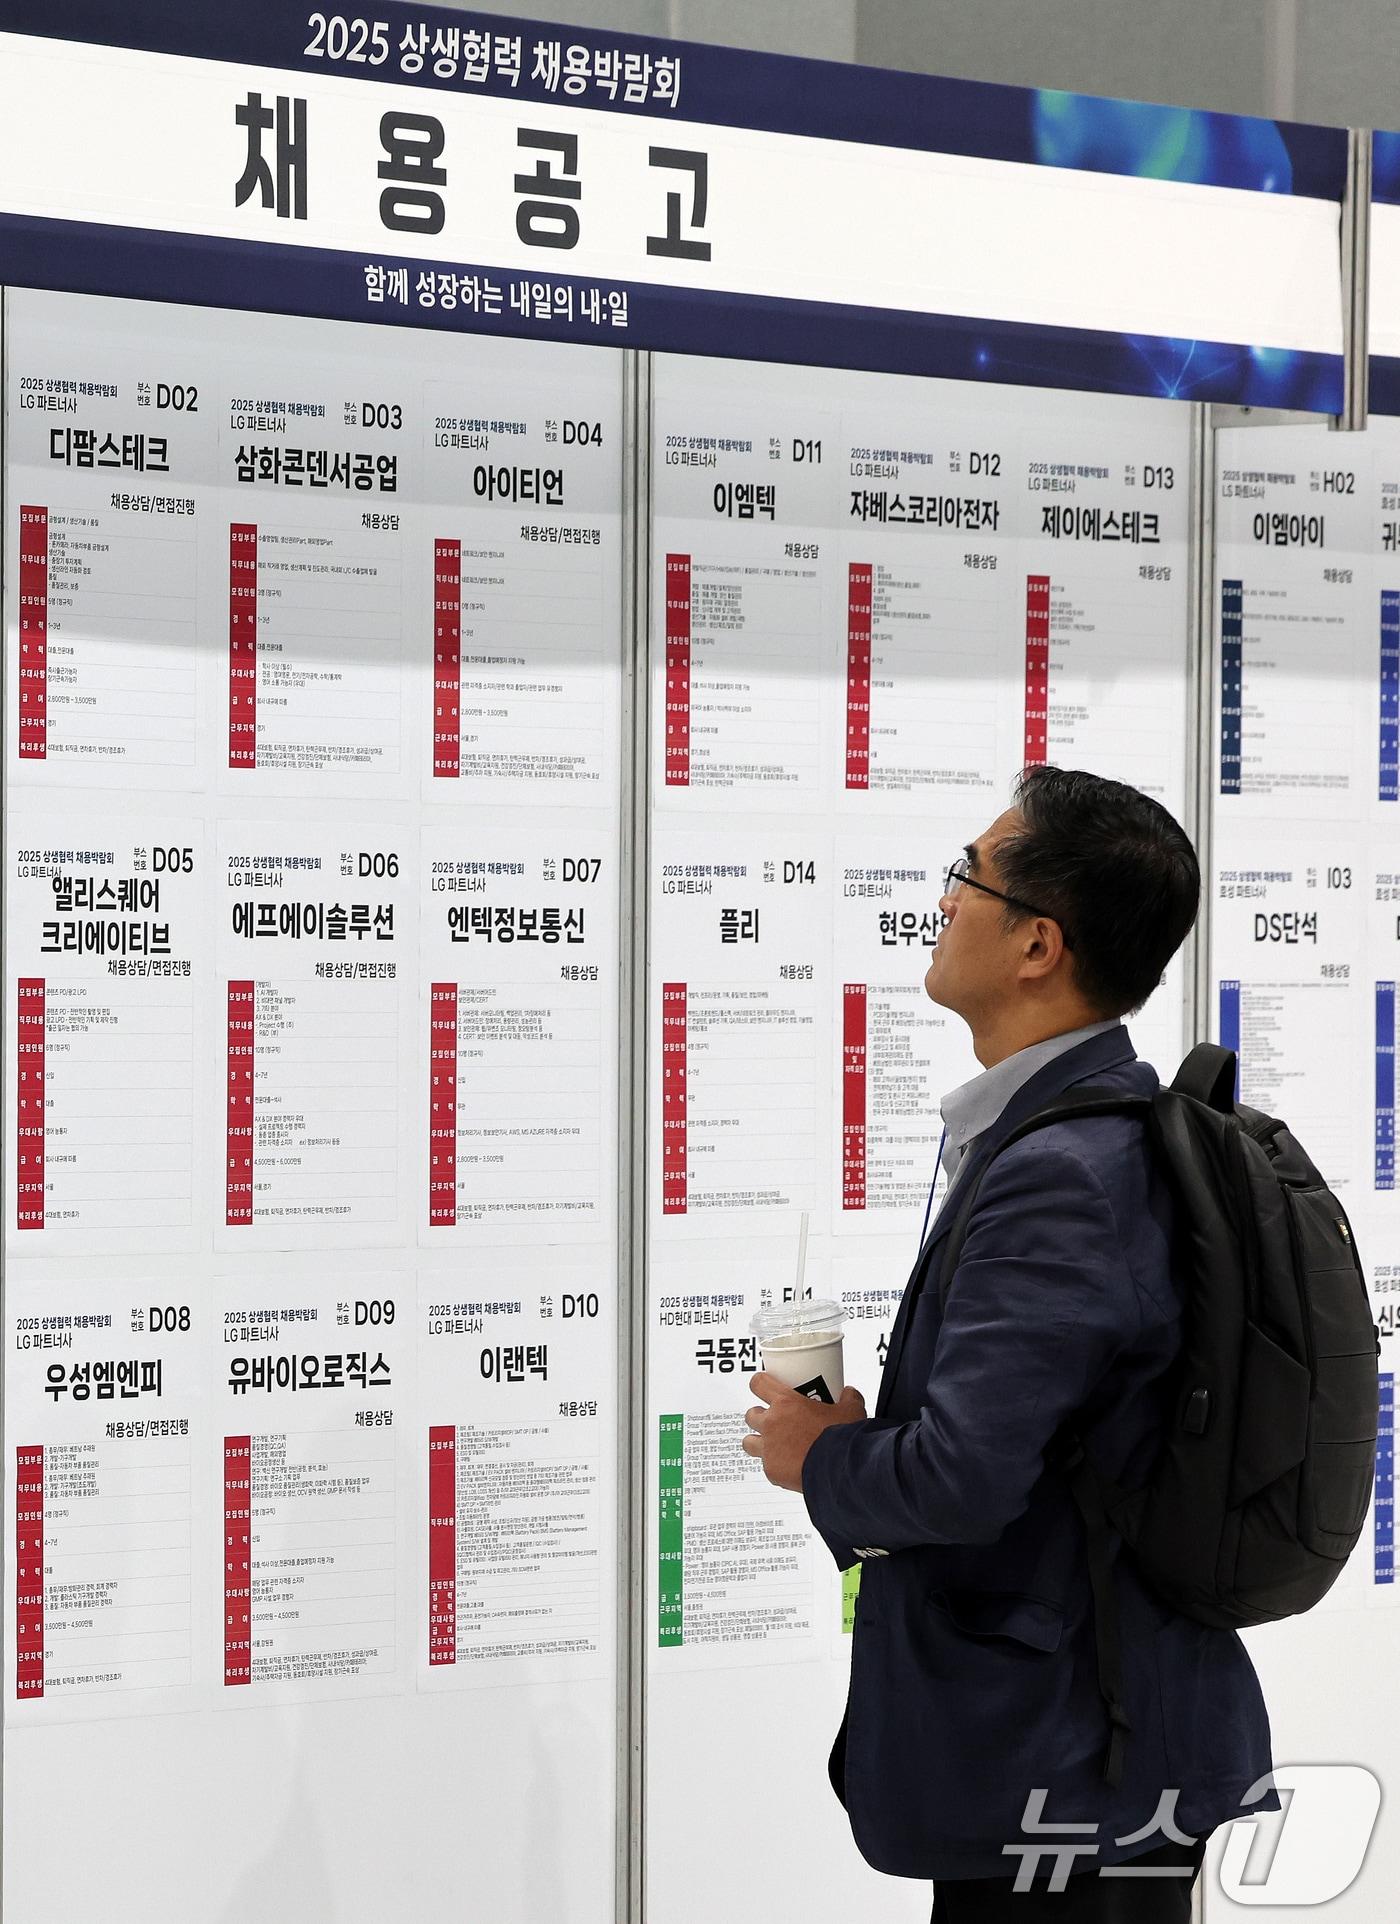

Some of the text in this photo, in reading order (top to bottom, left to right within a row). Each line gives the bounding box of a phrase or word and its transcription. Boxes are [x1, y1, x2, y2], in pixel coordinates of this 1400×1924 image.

[304, 12, 681, 107] 2025 상생협력 채용박람회
[365, 265, 627, 327] 함께 성장하는 내일의 내:일
[21, 378, 117, 397] 2025 상생협력 채용박람회
[138, 383, 151, 393] 부스
[21, 394, 77, 413] LG 파트너사
[138, 395, 150, 406] 번호
[157, 384, 197, 412] D02
[231, 399, 325, 417] 2025 상생협력 채용박람회
[344, 402, 357, 412] 부스
[231, 415, 286, 433] LG 파트너사
[344, 415, 357, 424] 번호
[363, 403, 402, 429] D03
[436, 418, 526, 434] 2025 상생협력 채용박람회
[545, 420, 557, 429] 부스
[563, 421, 602, 446] D04
[667, 436, 687, 447] 2025
[50, 428, 169, 472] 디팜스테크
[435, 433, 488, 451] LG 파트너사
[793, 439, 821, 463] D11
[851, 448, 870, 459] 2025
[666, 451, 716, 468] LG 파트너사
[970, 452, 1000, 476] D12
[235, 446, 396, 492] 삼화콘덴서공업
[474, 465, 563, 505] 아이티언
[1324, 472, 1354, 494] H02
[111, 493, 194, 515] 채용상담/면접진행
[714, 483, 775, 520] 이엠텍
[851, 490, 999, 531] 쟈베스코리아전자
[362, 513, 399, 530] 채용상담
[521, 526, 600, 544] 채용상담/면접진행
[1254, 513, 1323, 547] 이엠아이
[785, 544, 819, 559] 채용상담
[18, 851, 114, 864] 2025 상생협력 채용박람회
[134, 848, 146, 857] 부스
[153, 847, 193, 873] D05
[340, 853, 353, 862] 부스
[134, 860, 147, 870] 번호
[229, 856, 321, 869] 2025 상생협력 채용박람회
[341, 866, 353, 875] 번호
[359, 853, 398, 877] D06
[432, 862, 524, 874] 2025 상생협력 채용박람회
[543, 859, 556, 868] 부스
[563, 858, 601, 882] D07
[18, 866, 61, 880] LG 파트너사
[543, 871, 555, 880] 번호
[663, 865, 746, 877] 2025 상생협력 채용박람회
[784, 861, 815, 884] D14
[844, 869, 864, 879] 2025
[228, 872, 283, 887] LG 파트너사
[432, 878, 486, 892] LG 파트너사
[663, 880, 712, 894] LG 파트너사
[53, 874, 159, 912] 앨리스퀘어
[844, 884, 892, 897] LG 파트너사
[233, 902, 393, 940] 에프에이솔루션
[448, 907, 584, 943] 엔텍정보통신
[720, 909, 758, 943] 플리
[1255, 912, 1316, 944] DS단석
[41, 920, 171, 955] 크리에이티브
[108, 960, 190, 977] 채용상담/면접진행
[316, 962, 396, 979] 채용상담/면접진행
[561, 966, 598, 980] 채용상담
[780, 965, 813, 979] 채용상담
[337, 1303, 349, 1312] 부스
[540, 1296, 552, 1305] 부스
[563, 1294, 598, 1318] D10
[660, 1297, 680, 1307] 2025
[131, 1309, 144, 1318] 부스
[225, 1309, 317, 1323] 2025 상생협력 채용박람회
[355, 1300, 394, 1325] D09
[429, 1302, 520, 1316] 2025 상생협력 채용박람회
[540, 1308, 552, 1318] 번호
[17, 1315, 111, 1330] 2025 상생협력 채용박람회
[150, 1306, 190, 1332] D08
[337, 1315, 349, 1325] 번호
[660, 1310, 728, 1326] HD현대 파트너사
[131, 1321, 144, 1332] 번호
[225, 1326, 279, 1342] LG 파트너사
[429, 1319, 483, 1334] LG 파트너사
[17, 1333, 72, 1349] LG 파트너사
[696, 1337, 765, 1373] 극동전
[481, 1345, 547, 1382] 이랜텍
[45, 1359, 161, 1401] 우성엠엔피
[229, 1352, 391, 1394] 유바이오로직스
[559, 1401, 597, 1416] 채용상담
[355, 1410, 393, 1426] 채용상담
[106, 1419, 188, 1438] 채용상담/면접진행
